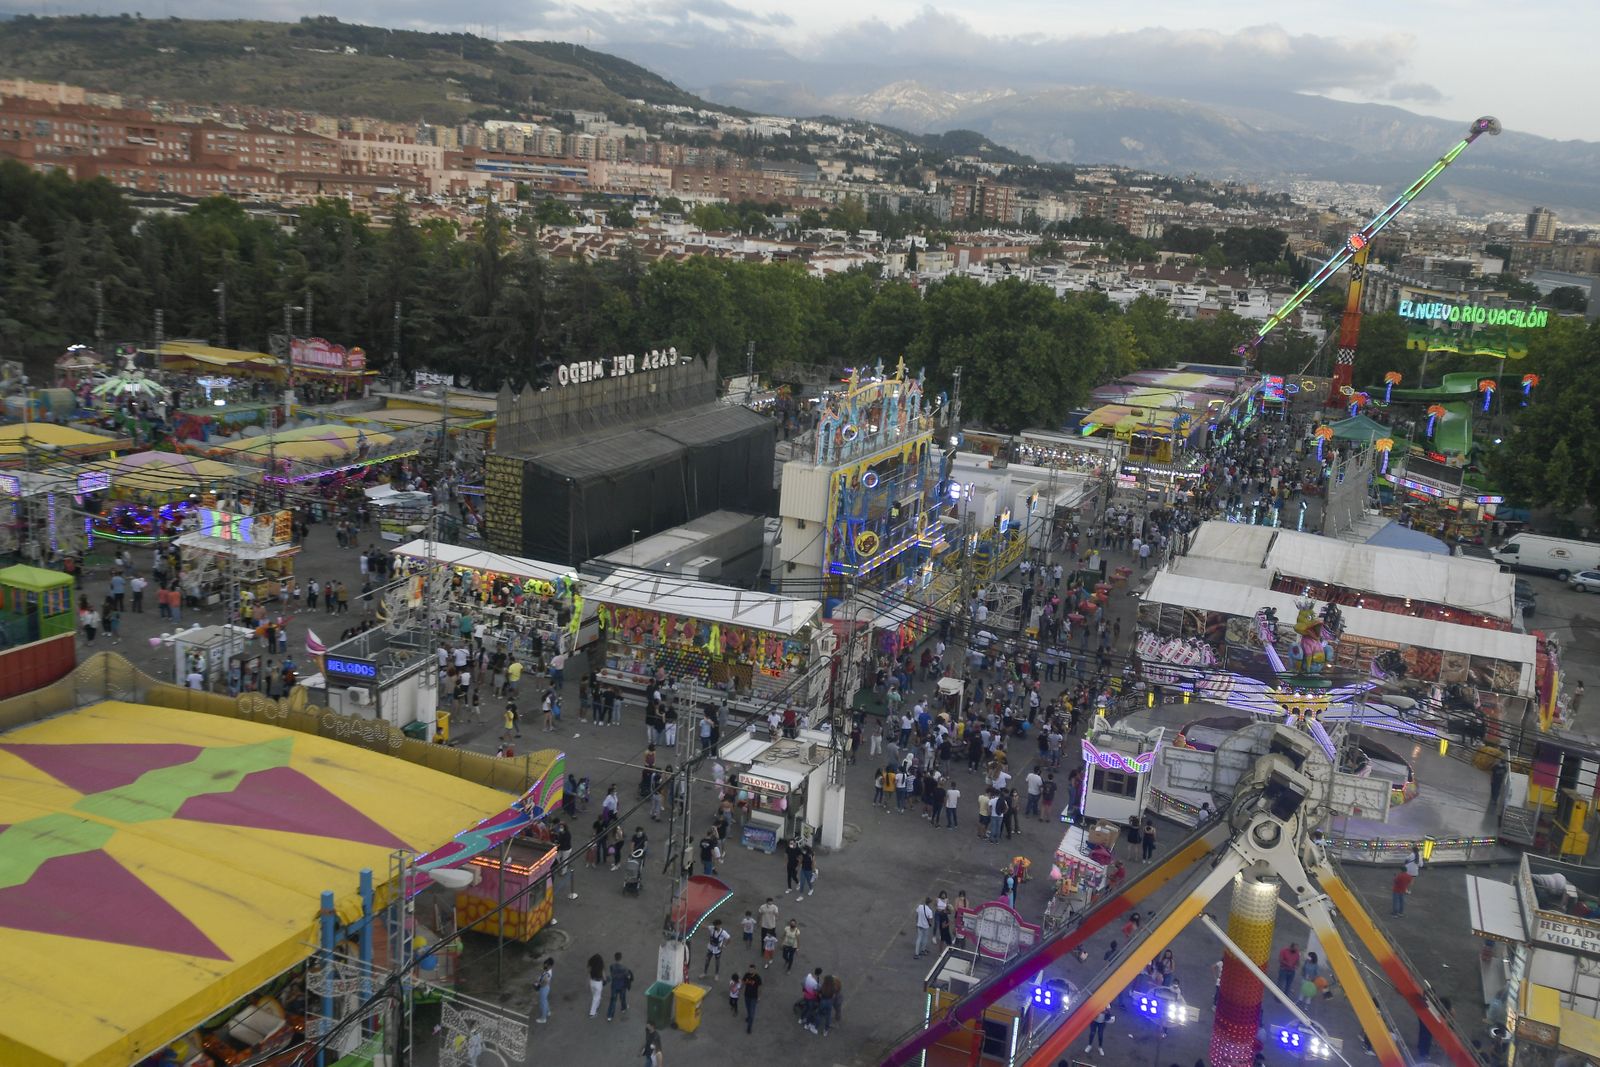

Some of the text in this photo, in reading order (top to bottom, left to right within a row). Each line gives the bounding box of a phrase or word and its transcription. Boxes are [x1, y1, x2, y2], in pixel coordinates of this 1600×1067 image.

[1399, 300, 1414, 317] EL
[1415, 303, 1460, 322] NUEVO
[1488, 305, 1548, 328] VACILÓN
[740, 775, 785, 791] PALOMITAS
